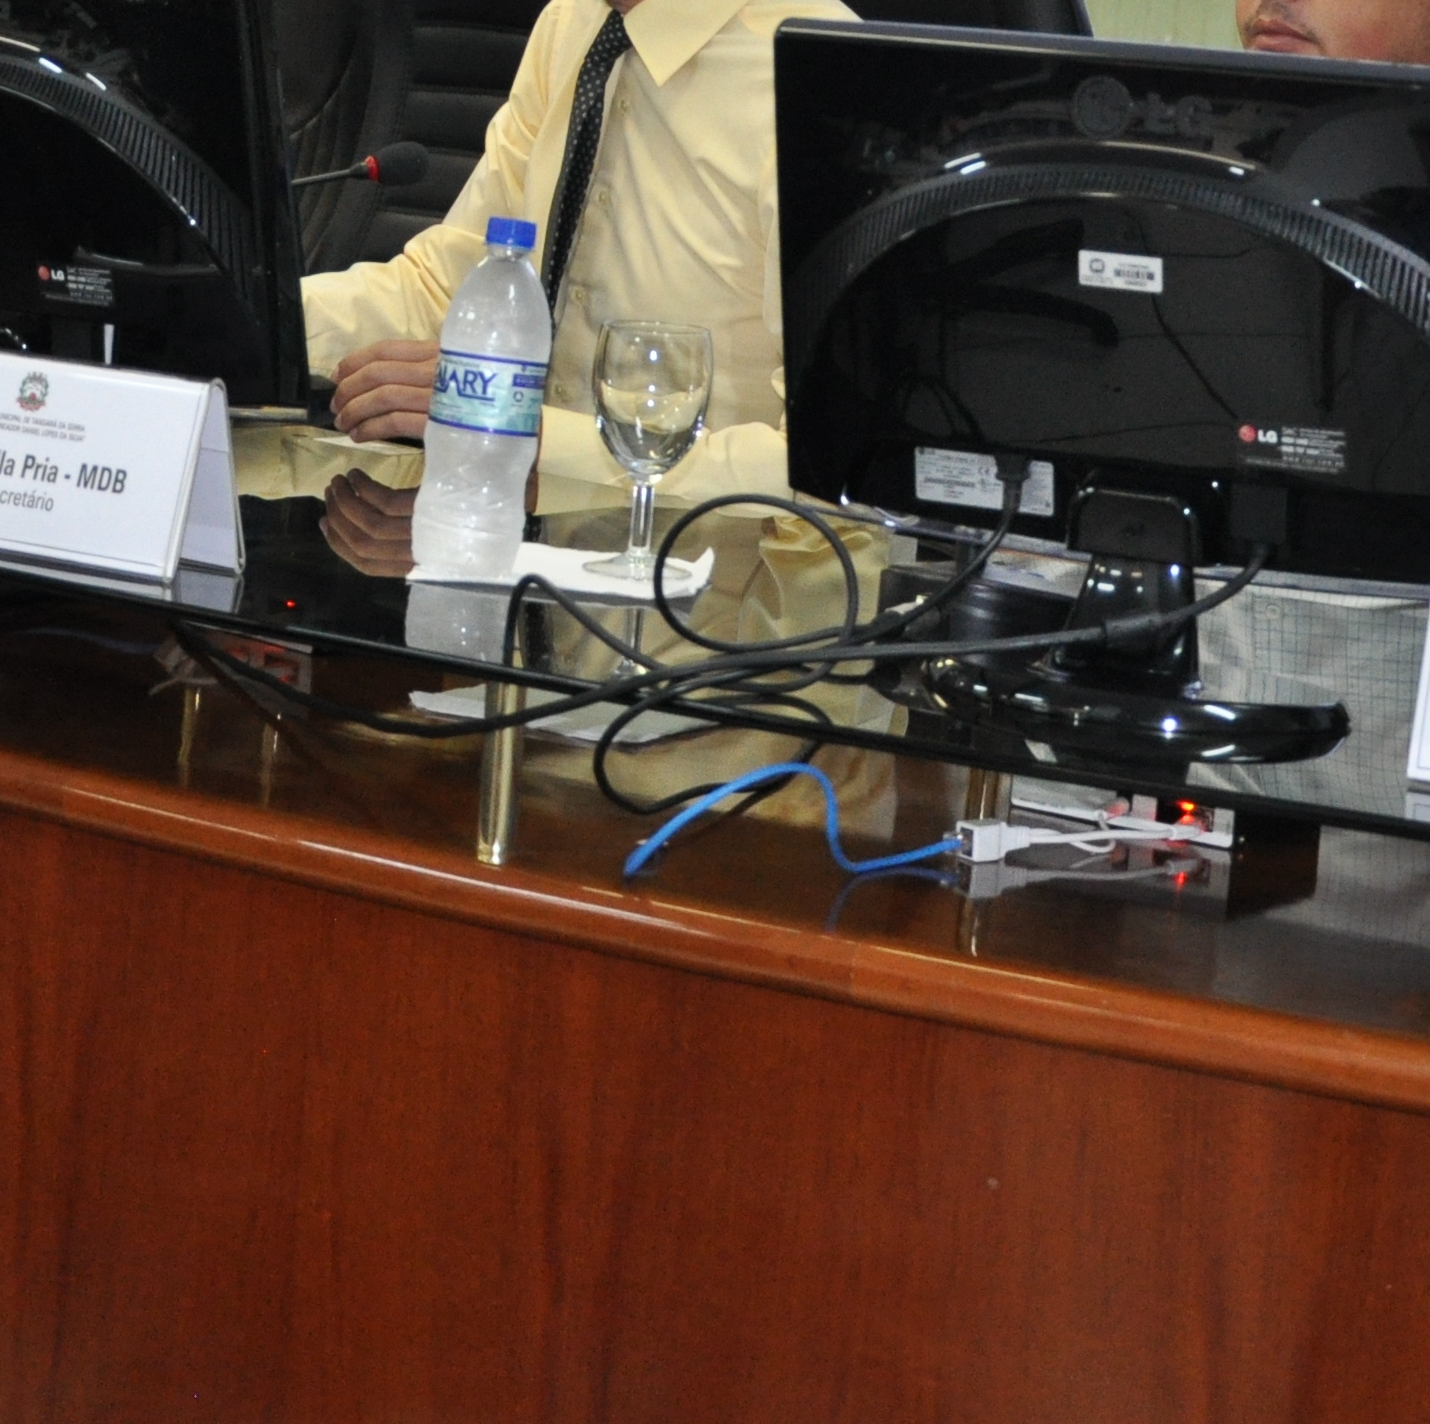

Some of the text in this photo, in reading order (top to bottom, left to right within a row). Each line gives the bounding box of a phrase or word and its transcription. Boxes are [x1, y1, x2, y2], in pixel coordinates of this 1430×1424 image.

[1146, 91, 1213, 136] LG
[1257, 429, 1278, 443] LG
[21, 454, 58, 484] Pria
[77, 463, 127, 494] MDB
